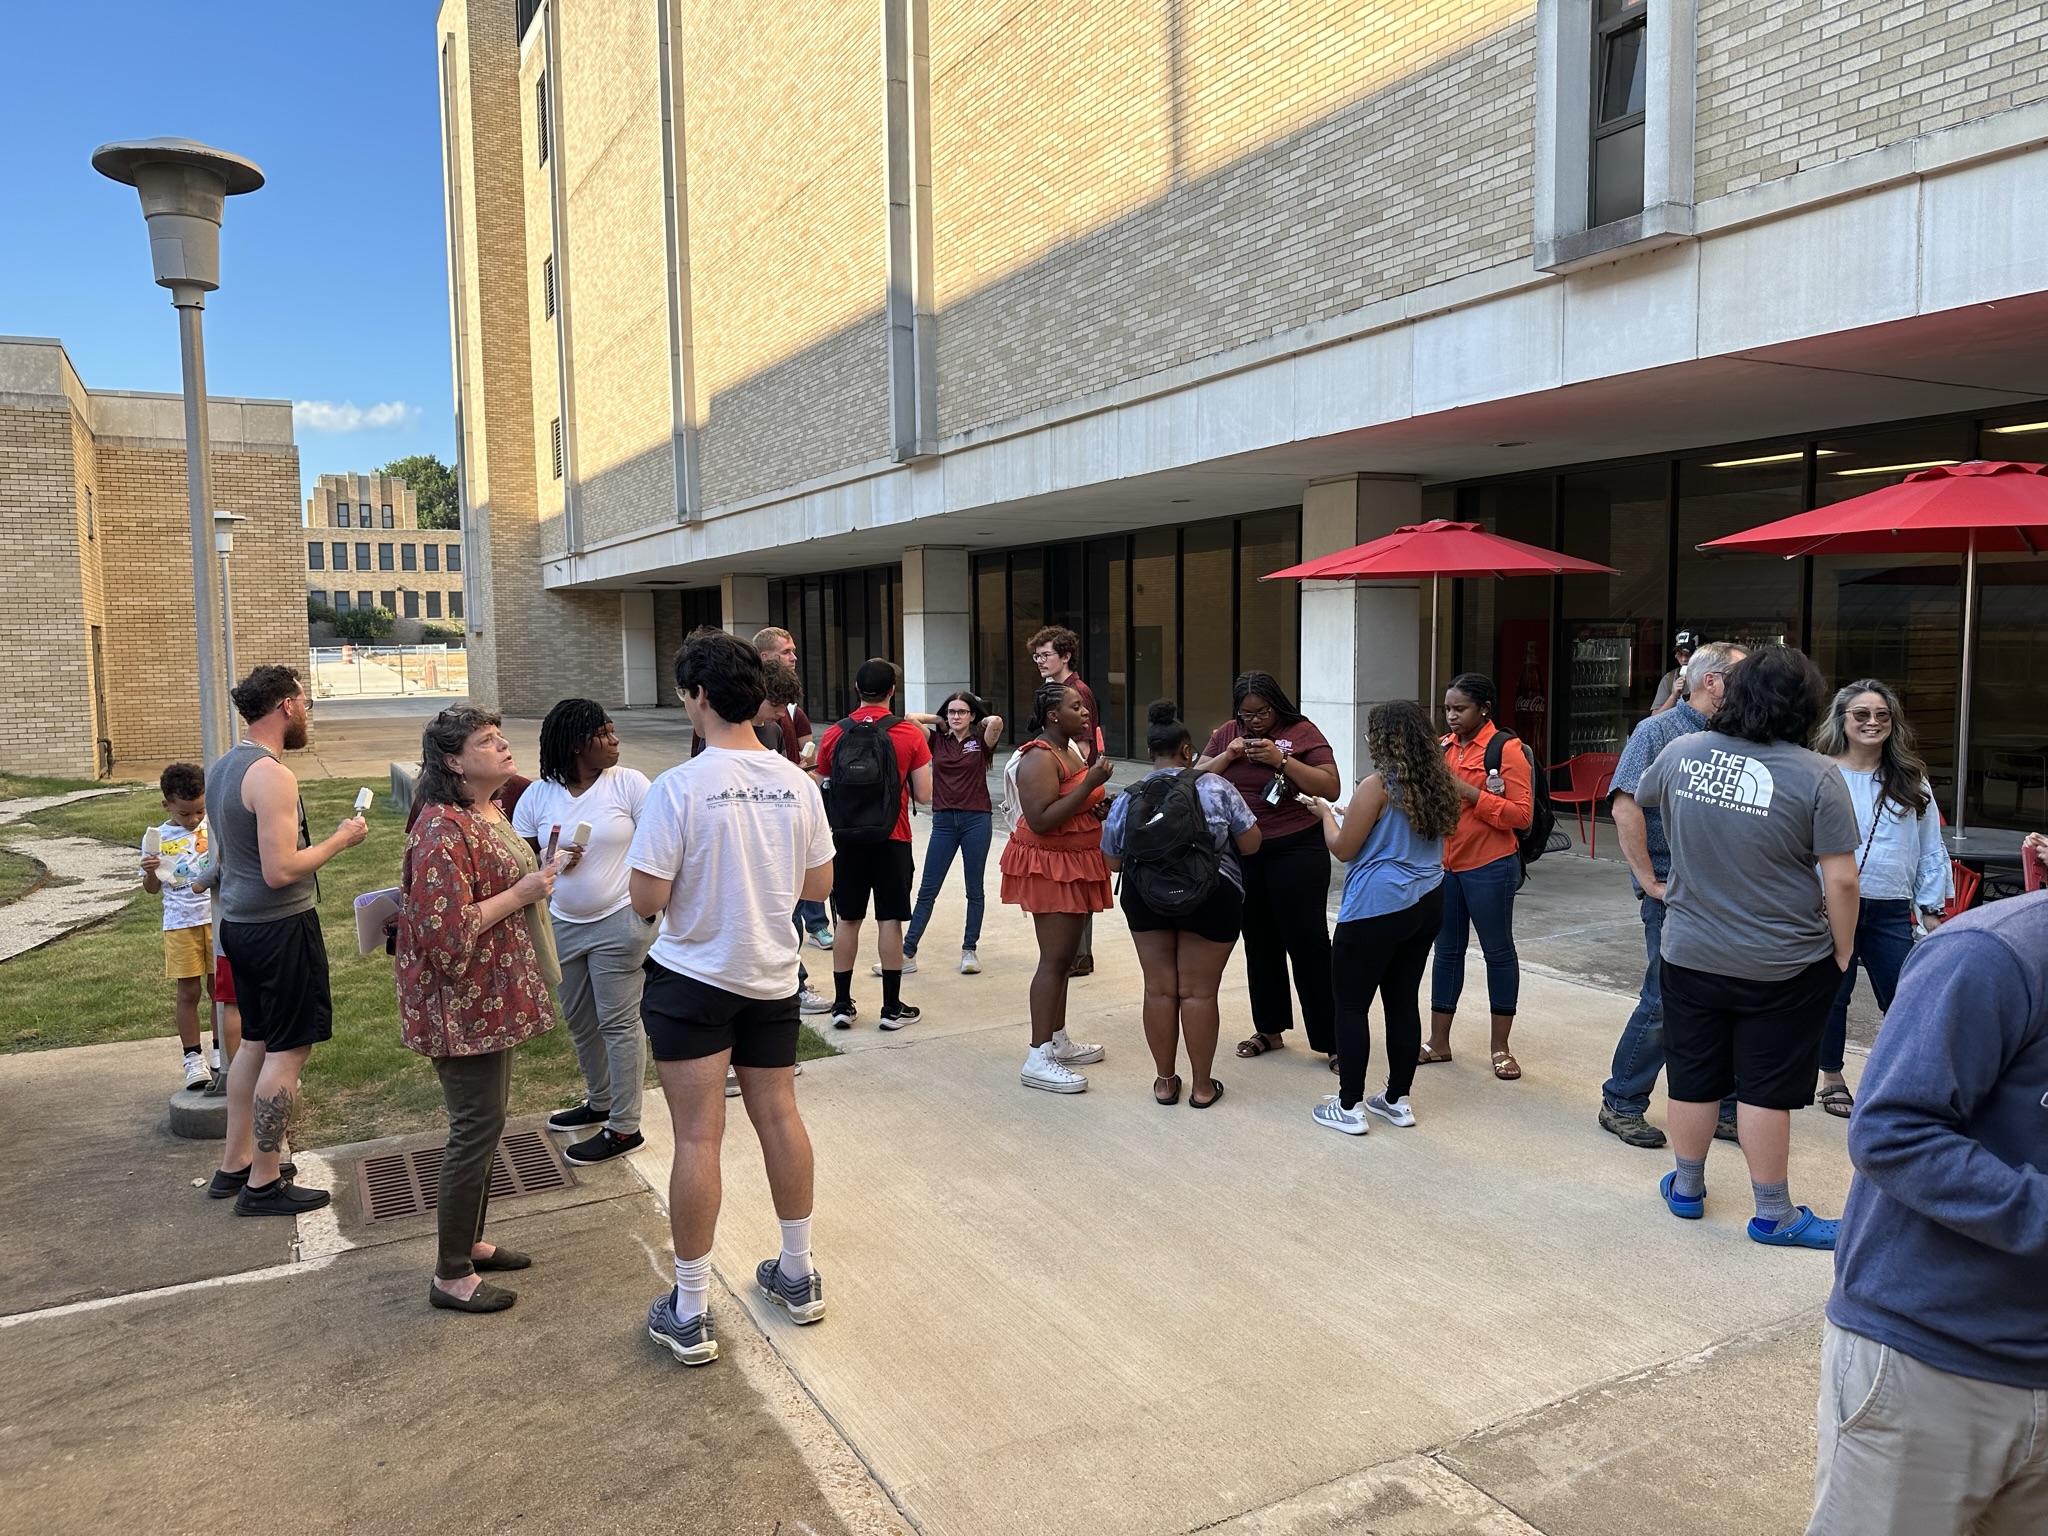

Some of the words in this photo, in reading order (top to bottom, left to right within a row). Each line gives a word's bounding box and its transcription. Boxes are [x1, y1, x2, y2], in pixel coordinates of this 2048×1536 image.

[1710, 749, 1746, 770] THE
[1679, 758, 1741, 785] NORTH
[1688, 776, 1735, 800] FACE
[1695, 794, 1717, 805] STOP
[1718, 800, 1769, 817] EXPLORING
